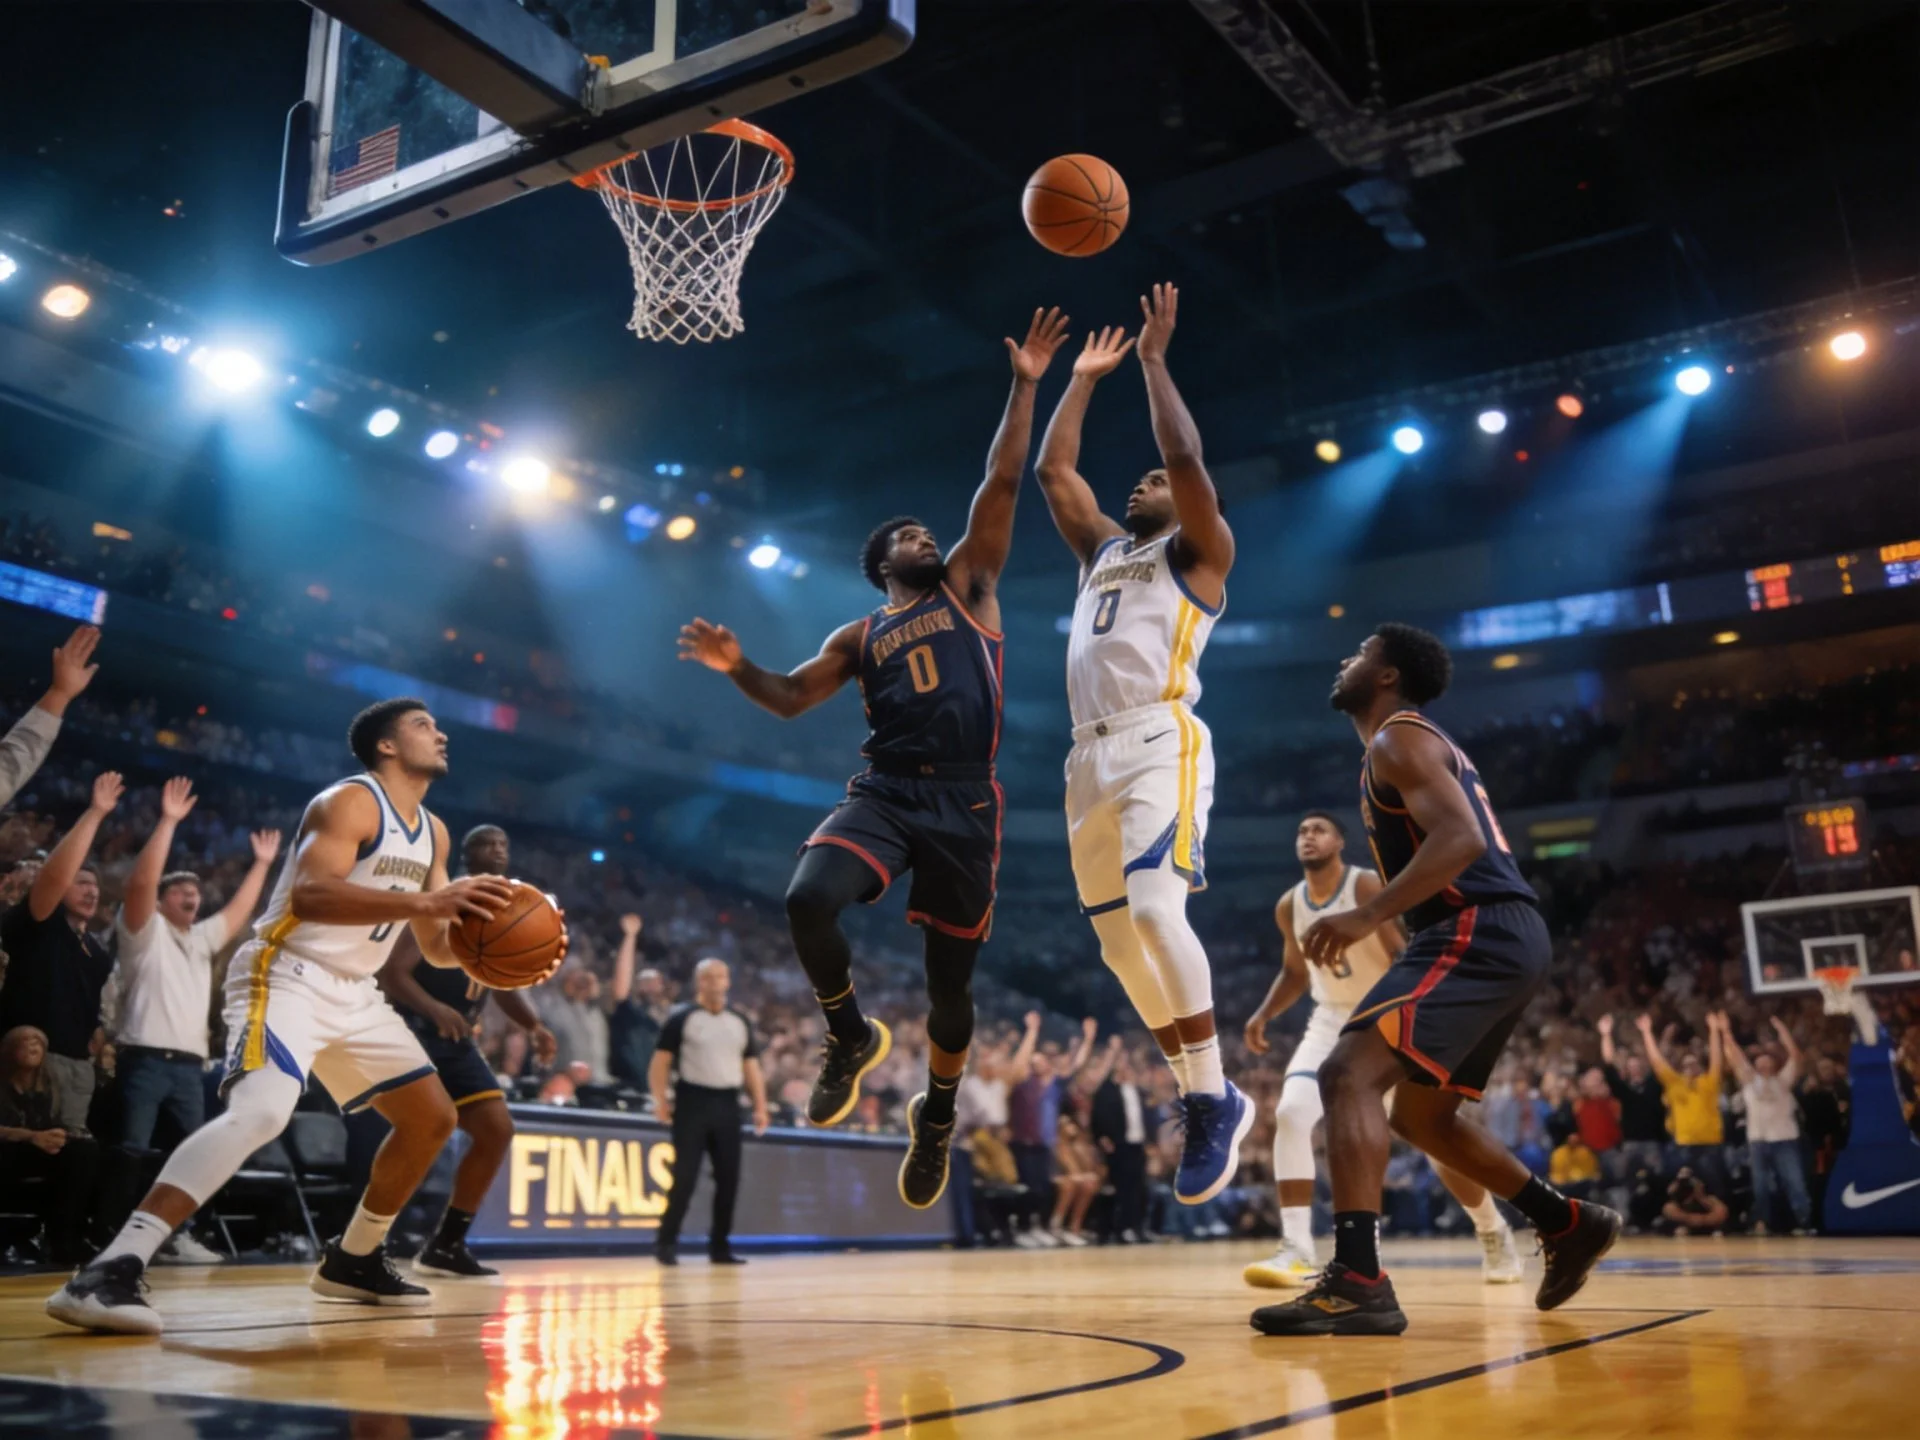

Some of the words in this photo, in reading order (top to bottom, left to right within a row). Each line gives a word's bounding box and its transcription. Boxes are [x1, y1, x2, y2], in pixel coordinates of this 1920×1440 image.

[1092, 588, 1122, 635] 0
[907, 644, 939, 693] 0
[509, 1133, 676, 1216] FINALS
